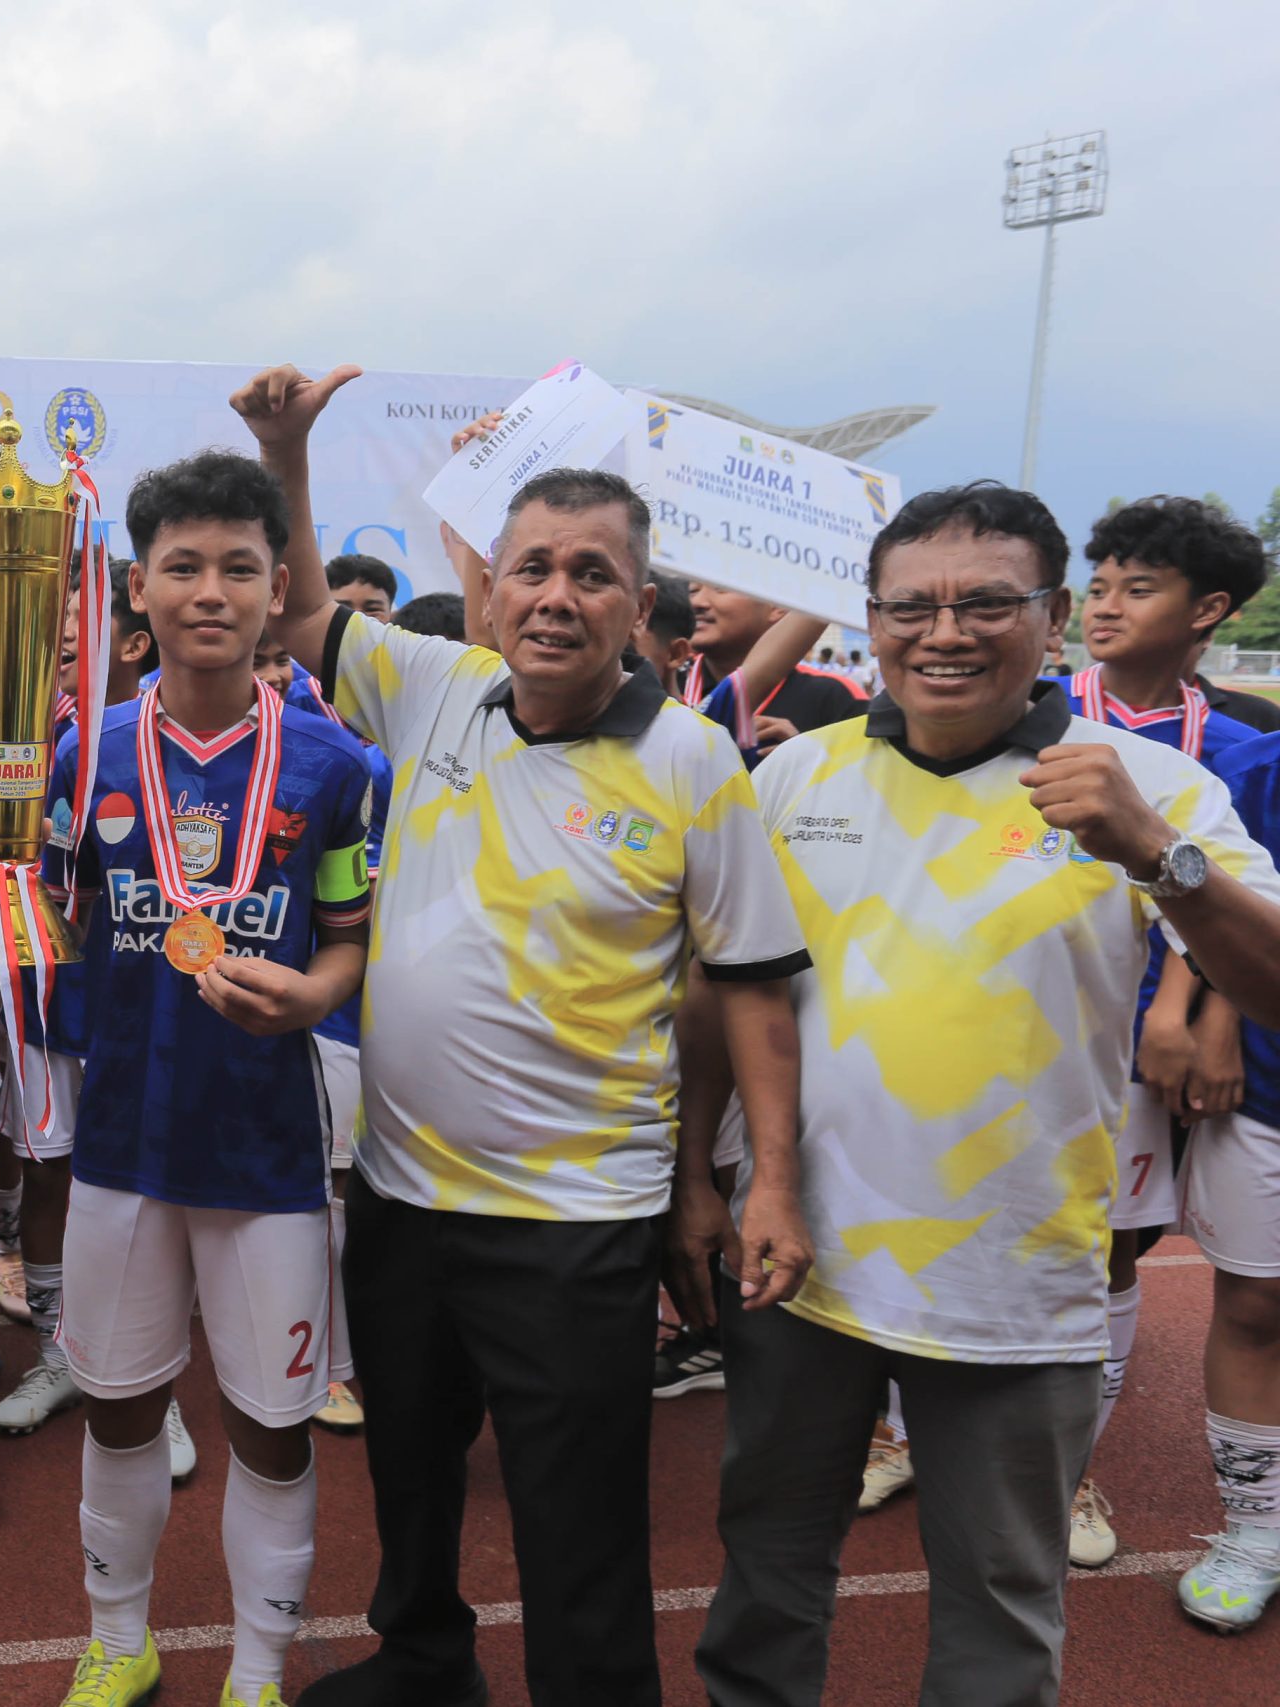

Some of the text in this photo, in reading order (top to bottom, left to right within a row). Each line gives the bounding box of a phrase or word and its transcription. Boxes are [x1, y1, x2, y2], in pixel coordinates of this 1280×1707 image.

[62, 406, 89, 416] PSSI
[386, 402, 434, 419] KONI
[469, 405, 534, 470] SERTIFIKAT
[508, 449, 542, 486] JUARA
[723, 455, 812, 500] JUARA 1
[658, 501, 869, 586] Rp. 15.000.00
[176, 822, 217, 836] ADHYAKSA FC
[842, 832, 864, 845] 2025
[1130, 1152, 1154, 1197] 7
[285, 1319, 315, 1379] 2
